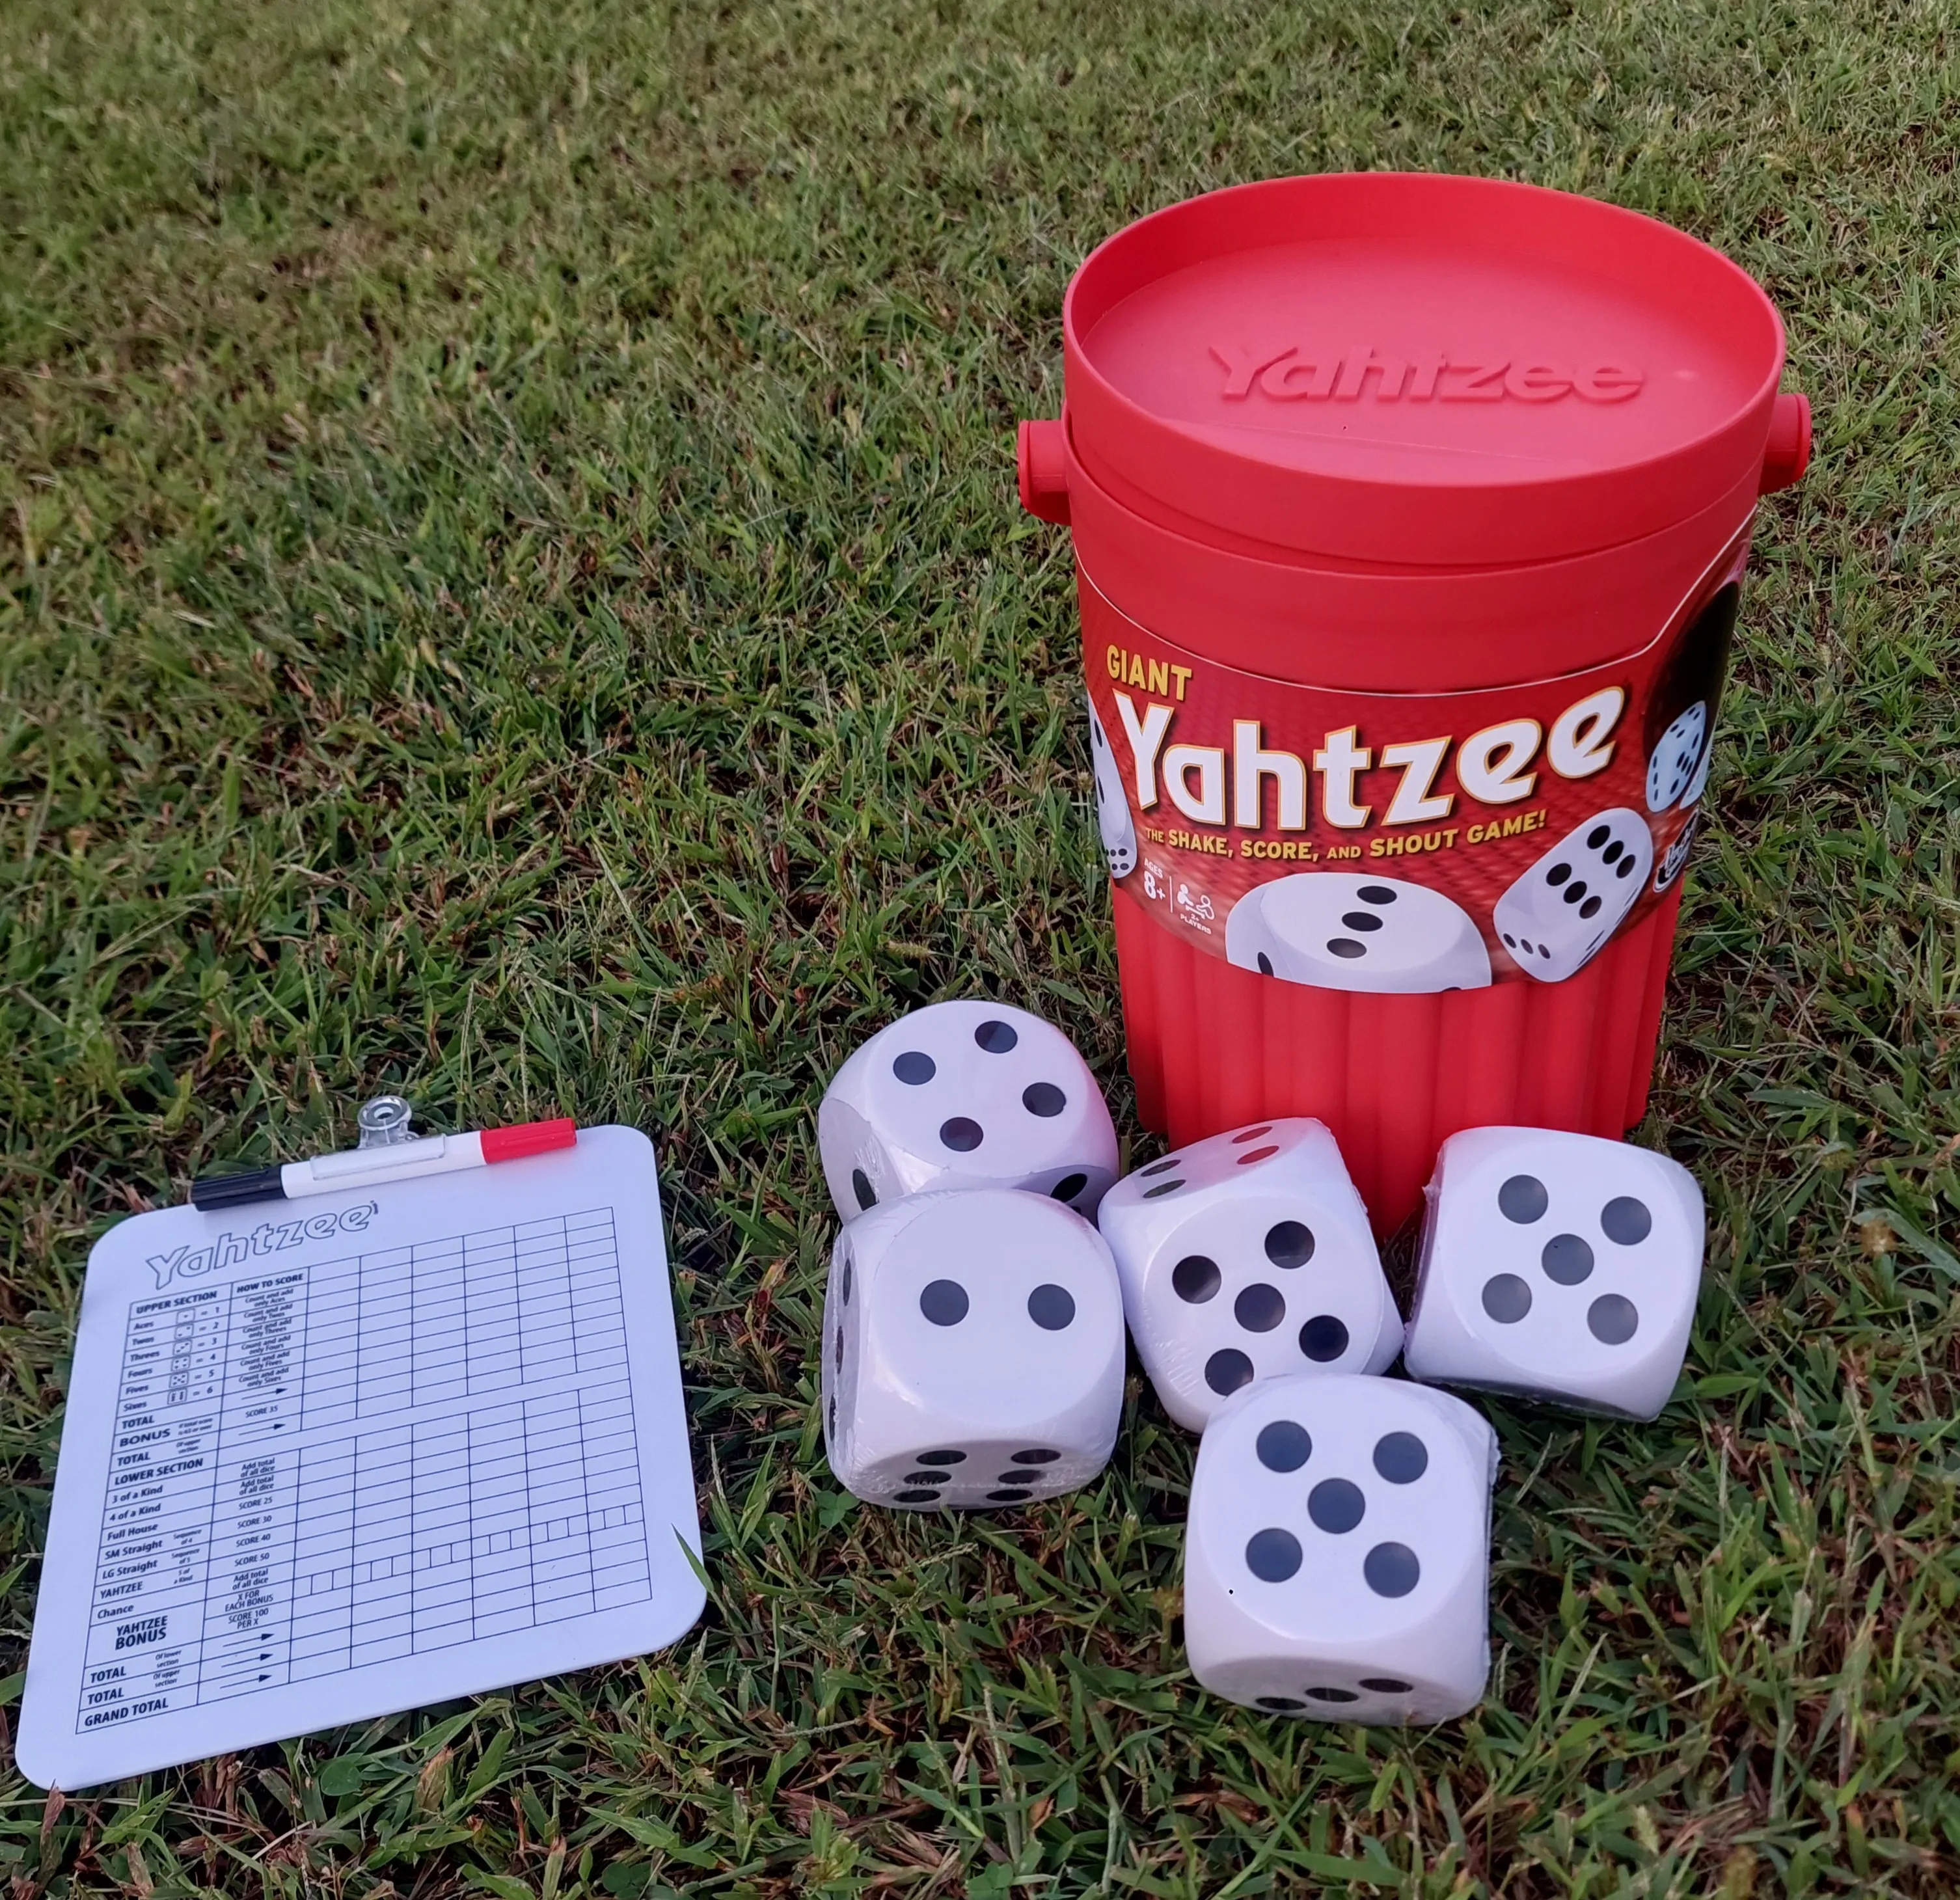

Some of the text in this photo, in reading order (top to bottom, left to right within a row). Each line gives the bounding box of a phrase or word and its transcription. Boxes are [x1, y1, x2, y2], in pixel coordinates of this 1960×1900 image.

[1208, 346, 1646, 404] Yahtzee
[1107, 644, 1193, 701] GIANT
[1112, 686, 1625, 831] Yahtzee
[1145, 809, 1546, 862] THE SHAKE, SCORE, AND SHOUT GAME!
[1145, 857, 1163, 878] AGES
[1144, 871, 1165, 900] 8+
[1180, 913, 1212, 934] PLAYERS
[146, 1205, 372, 1290] Yahtzee
[236, 1273, 304, 1294] HOW TO SCORE
[136, 1290, 217, 1314] UPPER SECTION
[245, 1294, 265, 1304] Count
[243, 1310, 264, 1318] Count
[133, 1322, 154, 1330] Aces
[242, 1325, 262, 1334] Count
[279, 1318, 292, 1326] add
[132, 1337, 154, 1346] Twos
[241, 1341, 262, 1350] Count
[130, 1351, 160, 1362] Threes
[240, 1357, 260, 1366] Count
[128, 1368, 153, 1378] Fours
[238, 1366, 290, 1383] Count and add
[126, 1385, 149, 1394] Fives
[208, 1369, 215, 1378] 5
[123, 1402, 147, 1412] Sixes
[206, 1386, 213, 1394] 6
[245, 1405, 279, 1418] SCORE 35
[122, 1415, 155, 1430] TOTAL
[119, 1428, 170, 1448] BONUS
[117, 1452, 151, 1467] TOTAL
[241, 1457, 275, 1471] Add total
[115, 1458, 204, 1486] LOWER SECTION
[249, 1468, 259, 1476] all
[240, 1474, 274, 1488] Add total
[112, 1495, 118, 1504] 3
[120, 1491, 131, 1502] of
[141, 1484, 163, 1497] Kind
[248, 1486, 257, 1494] all
[239, 1496, 273, 1510] SCORE 25
[118, 1510, 129, 1520] of
[139, 1502, 161, 1515] Kind
[238, 1515, 272, 1529] SCORE 30
[107, 1523, 158, 1541] Full House
[173, 1529, 202, 1540] Sequence
[236, 1536, 259, 1547] SCORE
[104, 1540, 163, 1560] SM Straight
[171, 1548, 200, 1559] Sequence
[234, 1552, 270, 1567] SCORE 50
[102, 1560, 158, 1580] LG Straight
[234, 1568, 268, 1582] Add total
[100, 1581, 143, 1599] YAHTZEE
[232, 1577, 269, 1590] of all dice
[225, 1593, 274, 1612] EACH BONUS
[238, 1589, 260, 1601] X FOR
[97, 1605, 134, 1619] Chance
[228, 1607, 269, 1624] SCORE 100
[116, 1615, 168, 1636] YAHTZEE
[237, 1618, 259, 1630] PER X
[115, 1627, 167, 1651] BONUS
[163, 1650, 182, 1659] lower
[157, 1659, 179, 1668] section
[90, 1666, 127, 1683] TOTAL
[161, 1670, 180, 1679] upper
[154, 1678, 178, 1688] section
[87, 1687, 124, 1705] TOTAL
[84, 1697, 169, 1727] GRAND TOTAL
